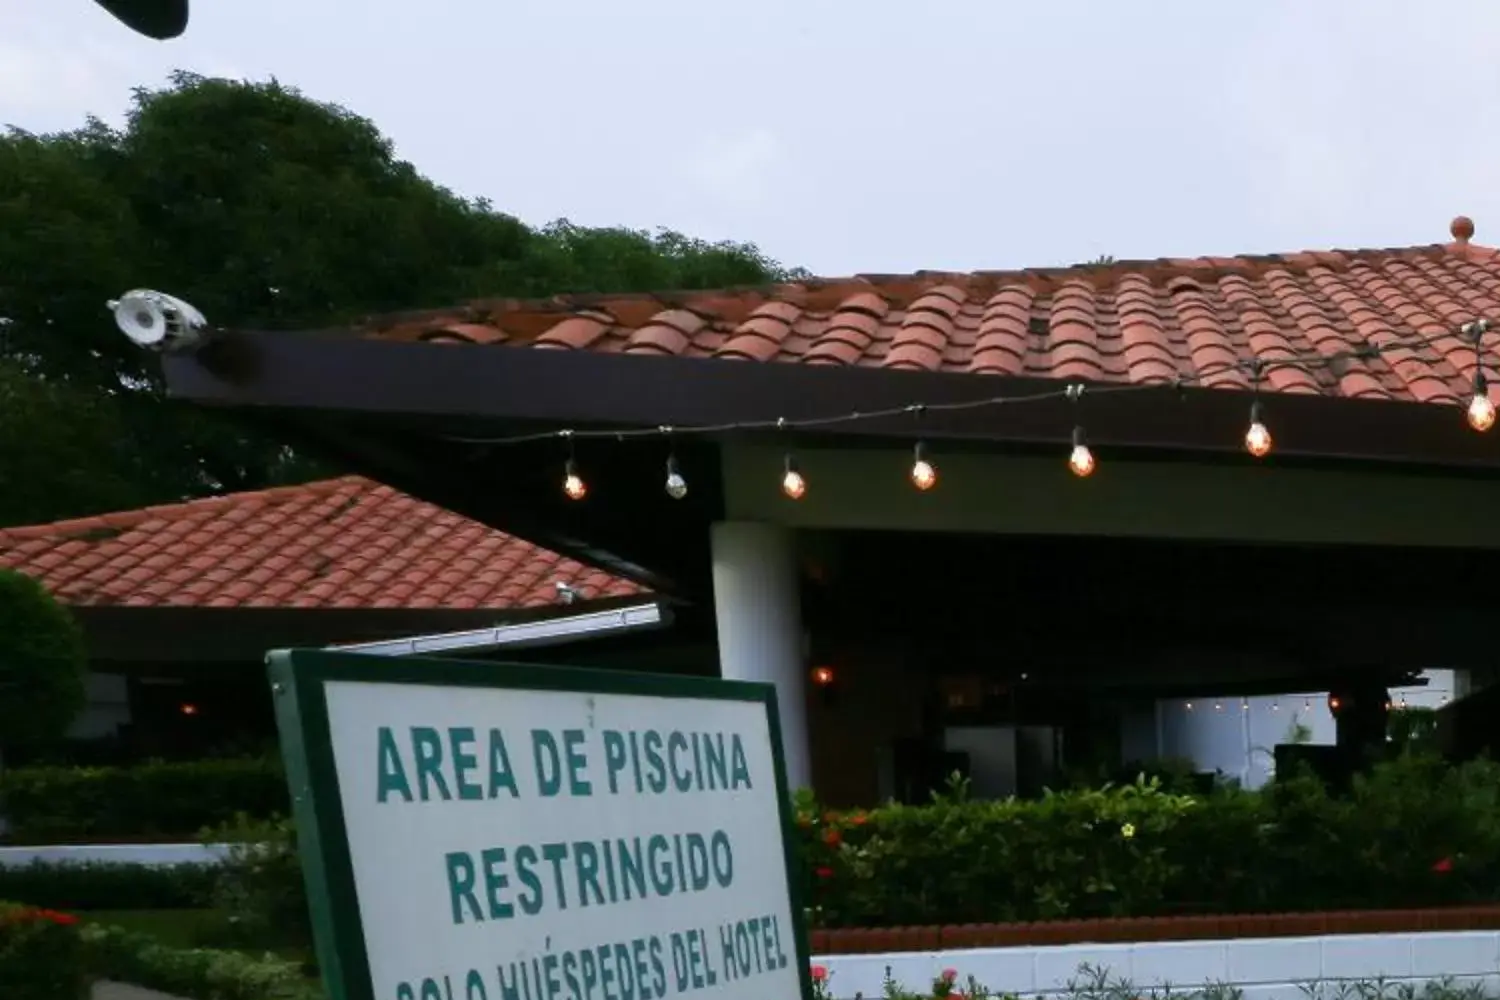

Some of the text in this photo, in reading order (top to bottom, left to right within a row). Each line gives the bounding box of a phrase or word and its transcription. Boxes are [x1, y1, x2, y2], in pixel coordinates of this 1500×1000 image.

[377, 726, 752, 802] AREA DE PISCINA
[445, 830, 733, 924] RESTRINGIDO
[670, 928, 716, 993] DEL
[721, 915, 787, 982] HOTEL
